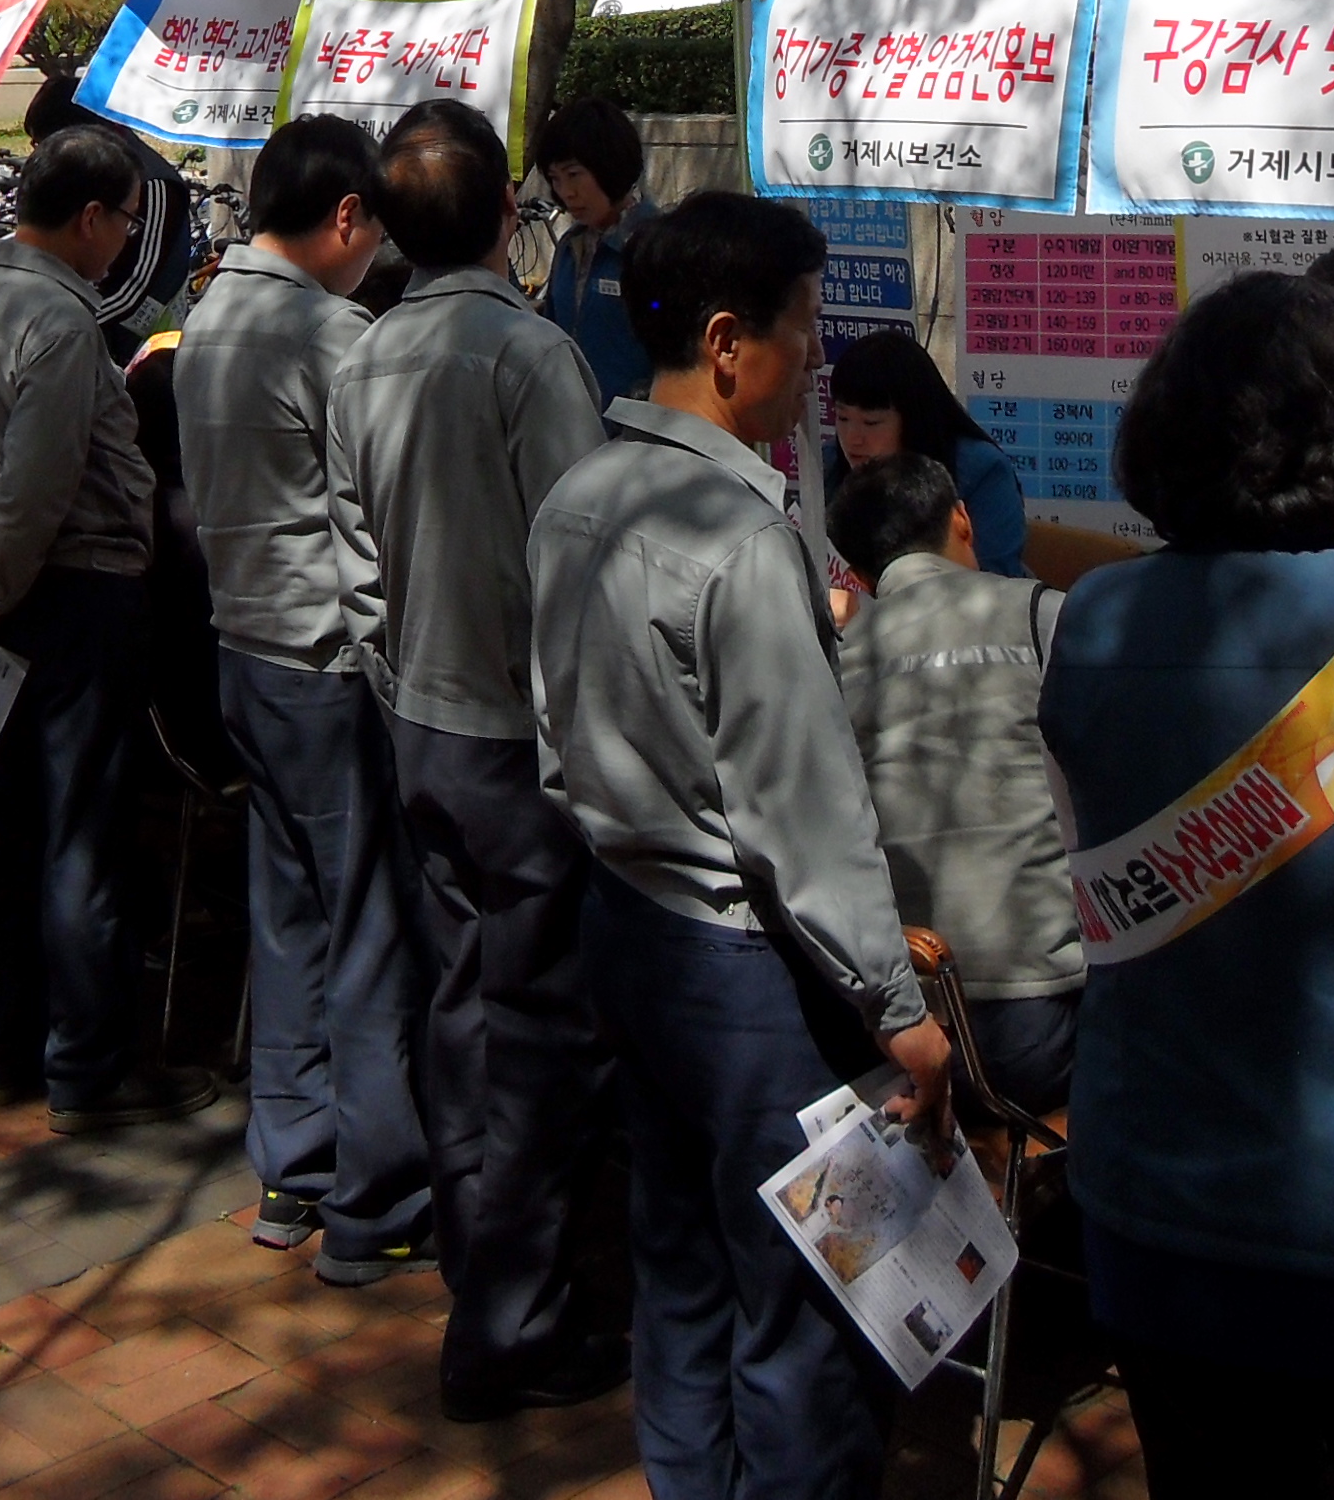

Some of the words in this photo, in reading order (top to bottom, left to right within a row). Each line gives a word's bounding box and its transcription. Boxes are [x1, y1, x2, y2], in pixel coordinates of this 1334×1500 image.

[317, 28, 395, 84] 뇌졸중
[391, 25, 490, 90] 자가진단
[1144, 18, 1309, 96] 구강검사
[204, 103, 276, 125] 거제시보건
[841, 138, 983, 170] 거제시보건소
[854, 224, 906, 243] 섭취합니다
[1301, 229, 1328, 245] 질환
[987, 238, 1016, 254] 구분
[828, 260, 850, 280] 매일
[854, 262, 880, 281] 30분
[884, 263, 906, 284] 이상
[1046, 264, 1067, 278] 120
[1114, 267, 1135, 279] and
[1138, 267, 1153, 279] 80
[849, 283, 883, 304] 합니다
[1046, 338, 1068, 352] 160
[988, 400, 1018, 418] 구분
[1052, 484, 1072, 498] 126
[1075, 483, 1097, 499] 이상
